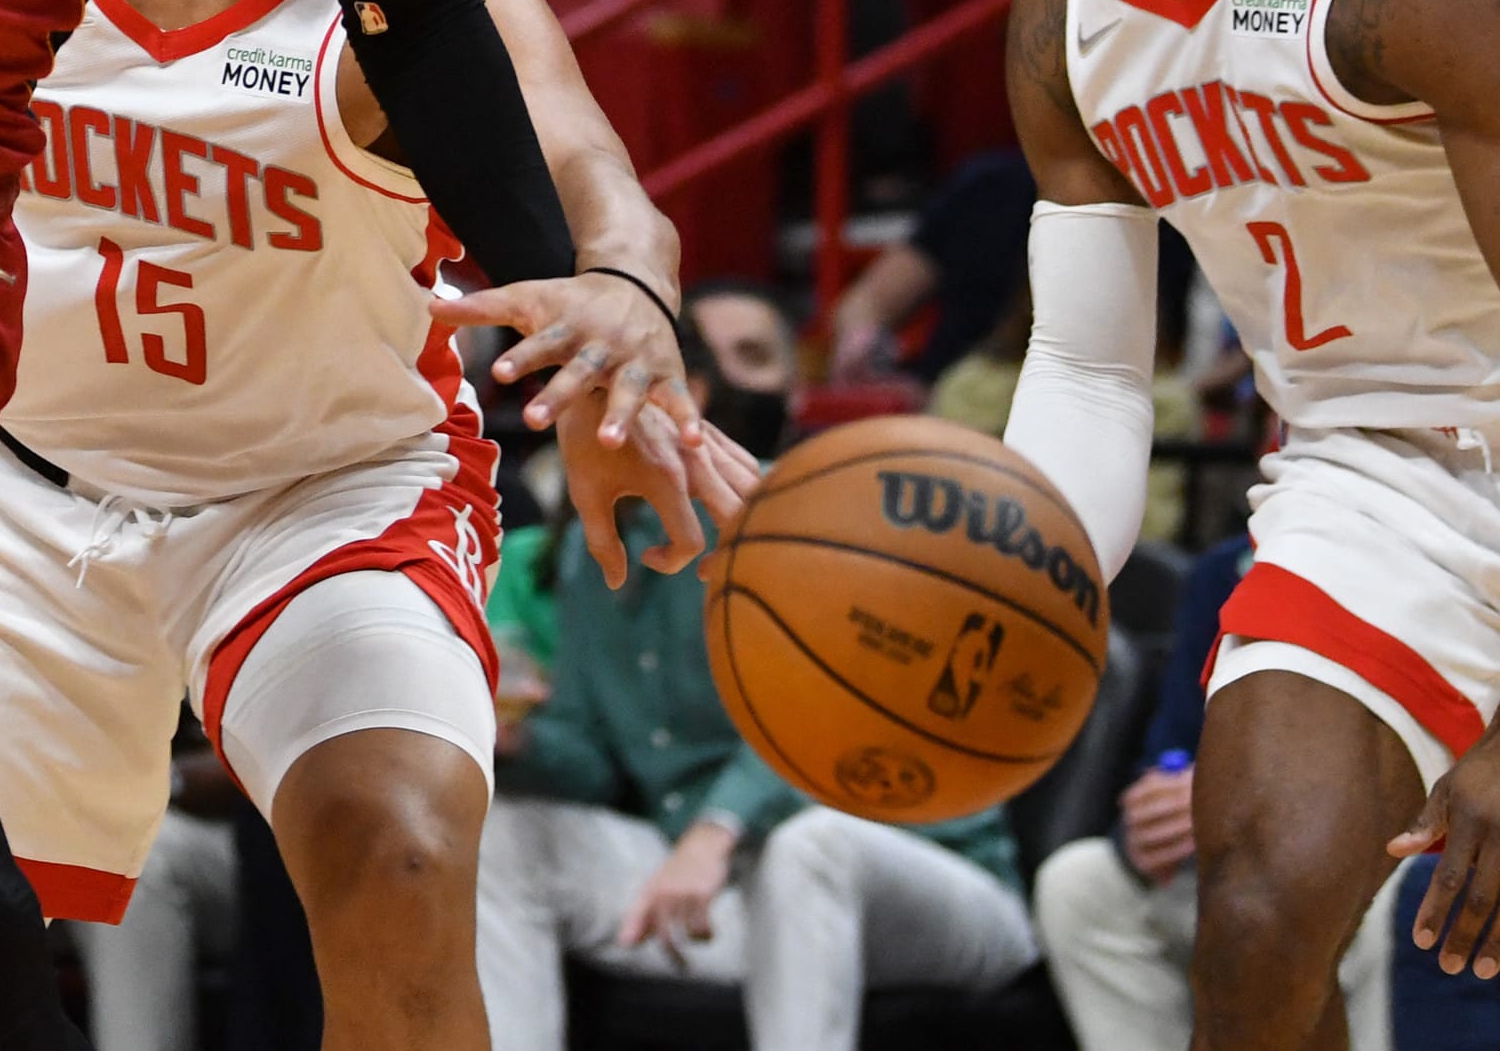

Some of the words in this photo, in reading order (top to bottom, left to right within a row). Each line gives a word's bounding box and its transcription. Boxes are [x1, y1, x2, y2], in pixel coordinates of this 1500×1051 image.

[222, 62, 310, 98] MONEY
[227, 48, 266, 65] credit
[268, 50, 313, 72] karma
[1232, 9, 1305, 34] MONEY
[20, 98, 324, 252] OCKETS
[1091, 78, 1372, 210] ROCKTS
[94, 235, 207, 386] 15
[1245, 220, 1354, 352] 2
[878, 470, 1099, 631] Wilson
